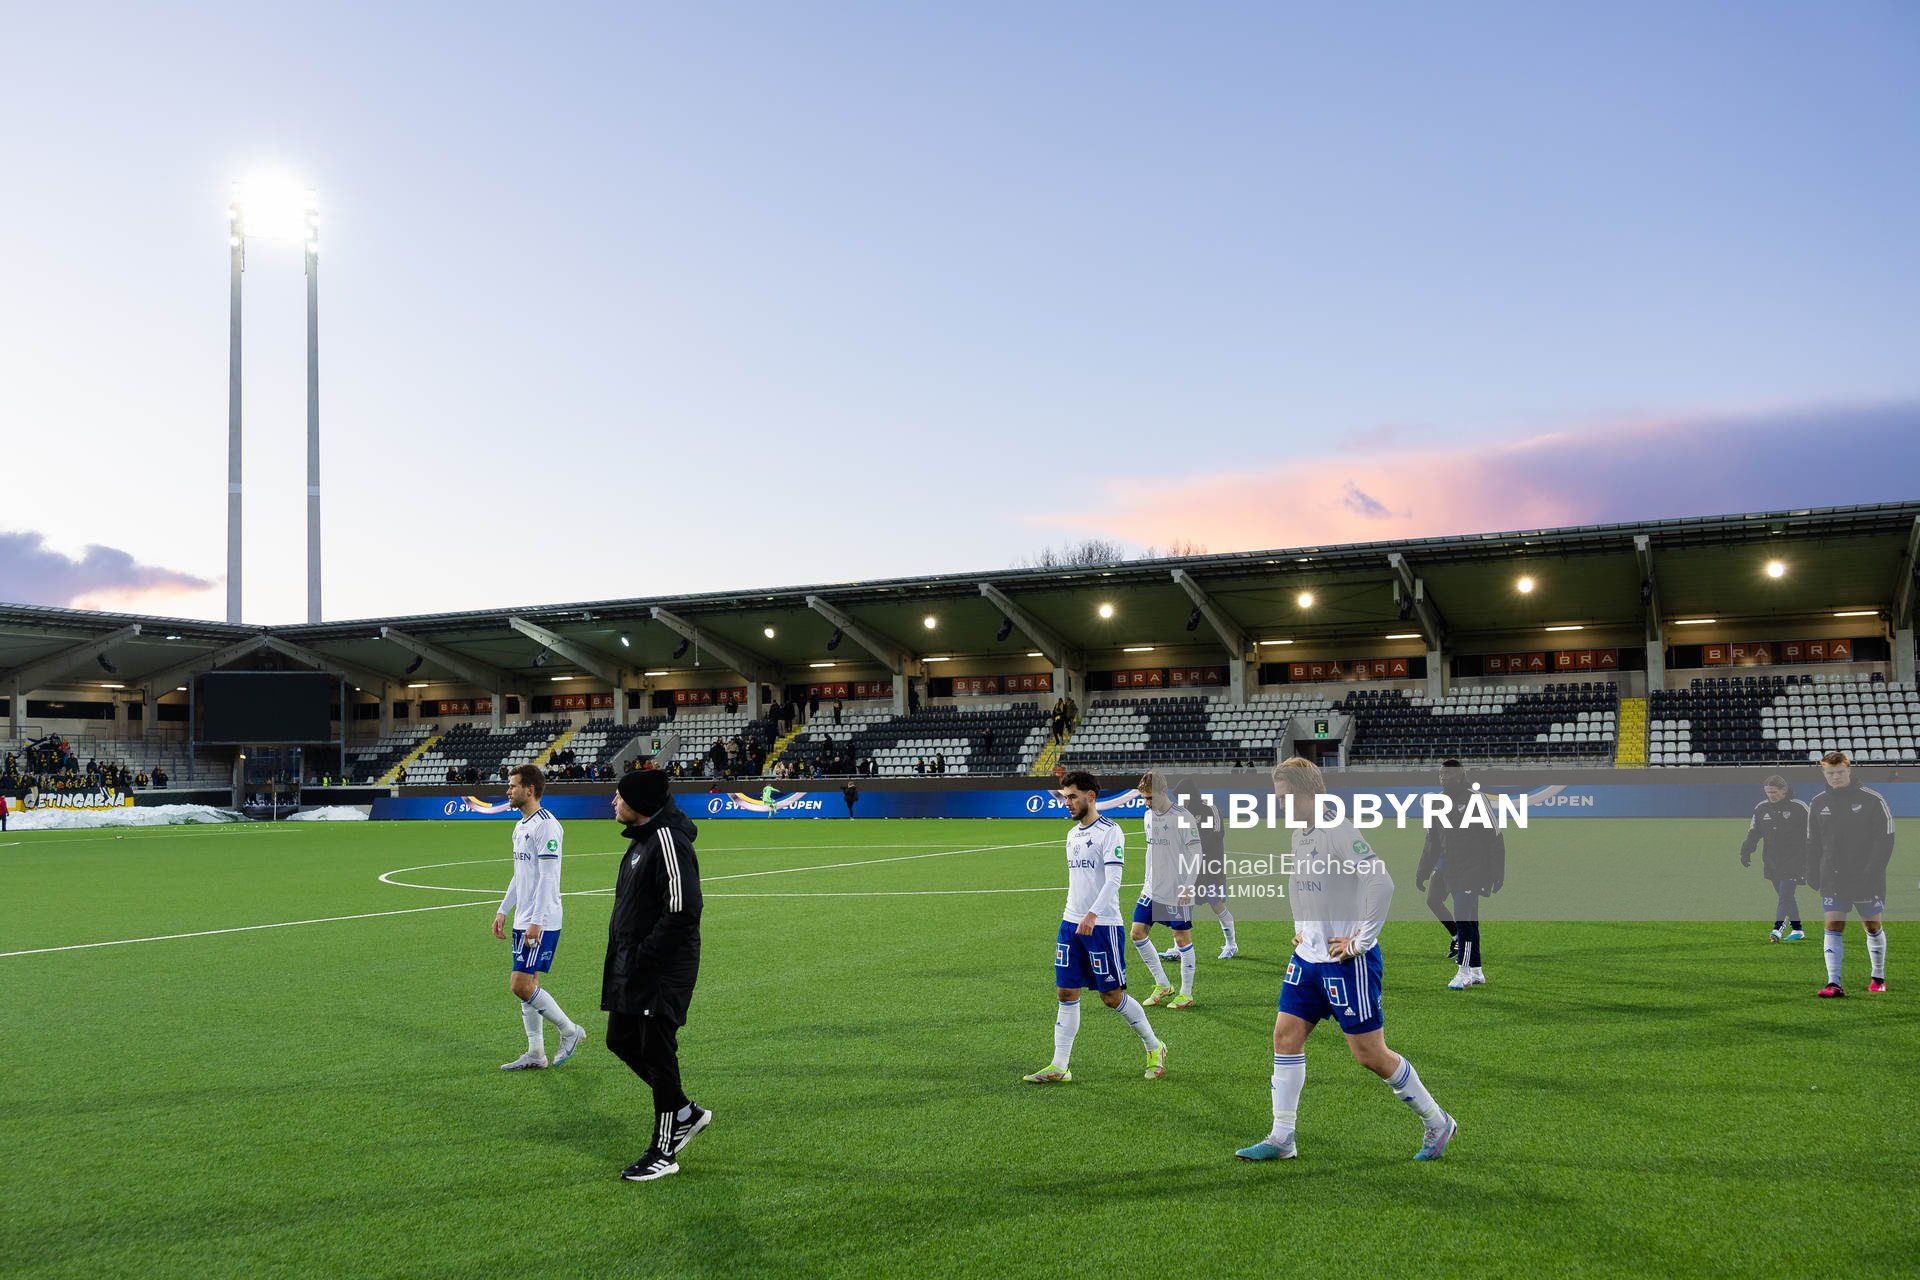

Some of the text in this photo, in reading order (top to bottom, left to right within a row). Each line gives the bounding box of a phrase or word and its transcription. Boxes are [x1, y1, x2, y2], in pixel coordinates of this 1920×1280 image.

[1709, 644, 1848, 659] BRA BRA
[1490, 655, 1614, 668] BRA BRA
[1294, 663, 1404, 676] BRA BRA
[1118, 671, 1217, 683] BRA BRA
[957, 678, 1048, 689] BRA BRA
[554, 696, 613, 706] BRA BR
[678, 691, 748, 701] BRA BR
[440, 702, 469, 711] BRA
[1318, 723, 1325, 733] E
[783, 800, 822, 810] UPEN
[1823, 897, 1833, 906] 22
